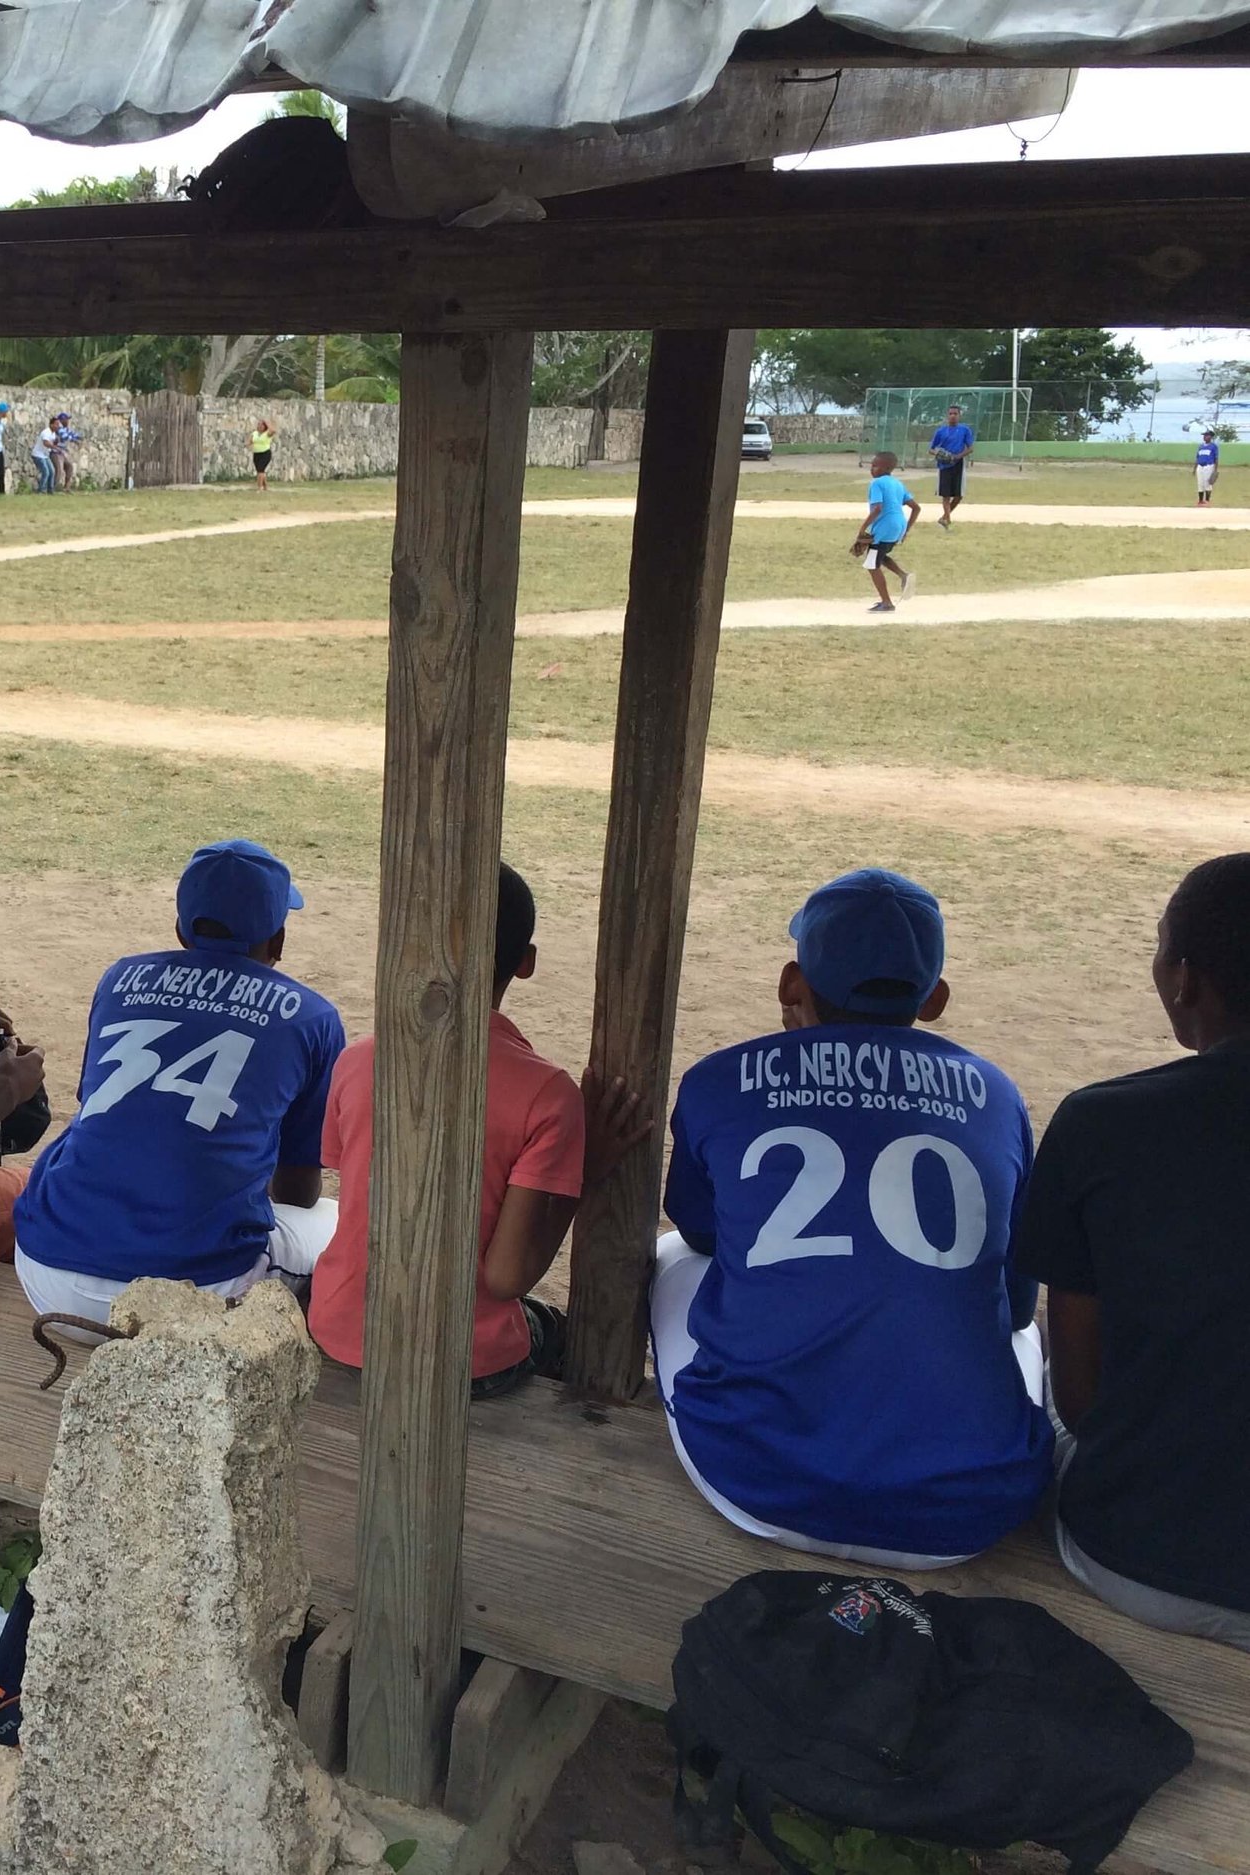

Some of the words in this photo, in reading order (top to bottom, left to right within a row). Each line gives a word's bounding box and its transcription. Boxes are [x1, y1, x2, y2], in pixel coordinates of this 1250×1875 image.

[112, 964, 155, 995] LIC.
[153, 964, 234, 999] NERCY
[229, 975, 301, 1020] BRITO
[122, 994, 184, 1008] SINDICO
[186, 998, 269, 1027] 2016-2020
[80, 1018, 255, 1132] 34
[739, 1047, 790, 1093] LIC.
[800, 1042, 891, 1092] NERCY
[900, 1050, 987, 1109] BRITO
[767, 1090, 853, 1108] SINDICO
[861, 1092, 968, 1124] 2016-2020
[739, 1125, 987, 1270] 20
